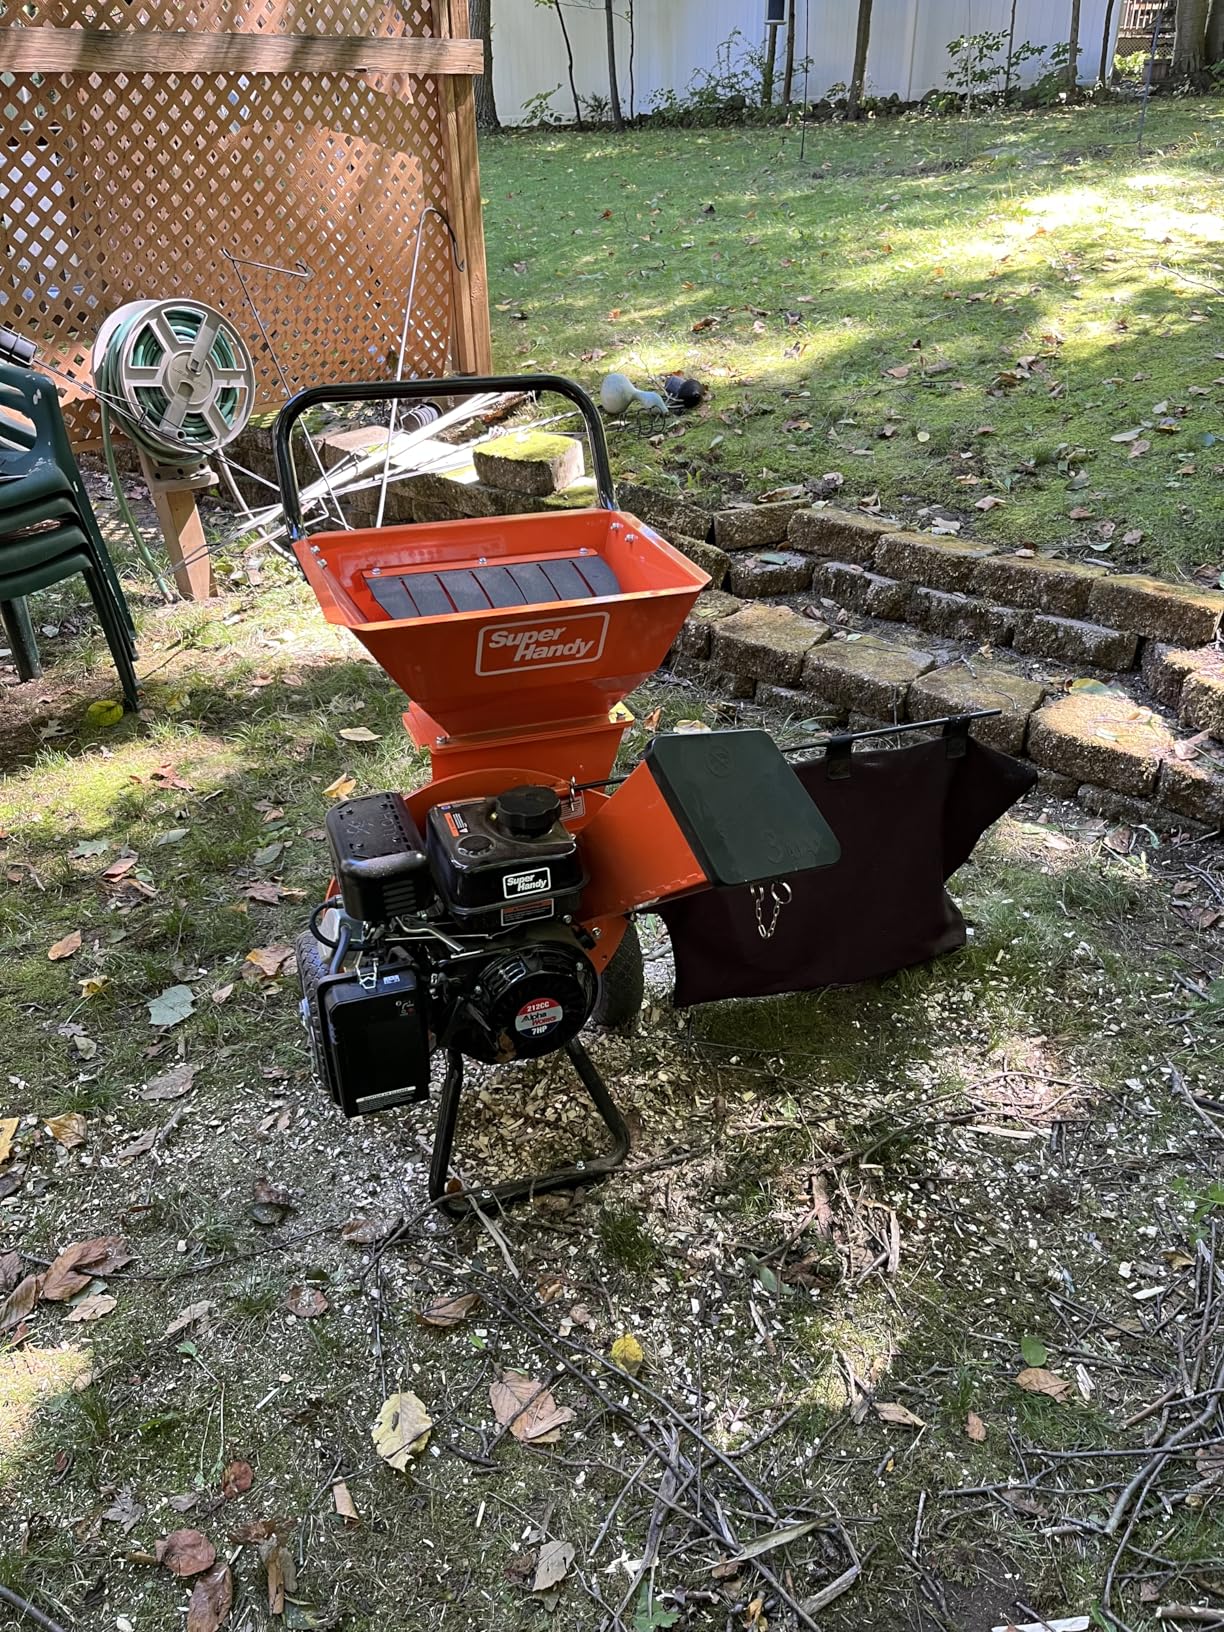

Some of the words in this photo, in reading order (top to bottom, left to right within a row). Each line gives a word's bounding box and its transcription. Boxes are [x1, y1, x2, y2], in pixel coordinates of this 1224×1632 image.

[489, 626, 566, 649] Super
[513, 638, 595, 662] Handy
[507, 874, 535, 886] Super
[517, 879, 547, 892] Handy
[527, 1001, 550, 1012] 212CC
[521, 1012, 547, 1023] Alpha
[531, 1025, 547, 1035] 7HP
